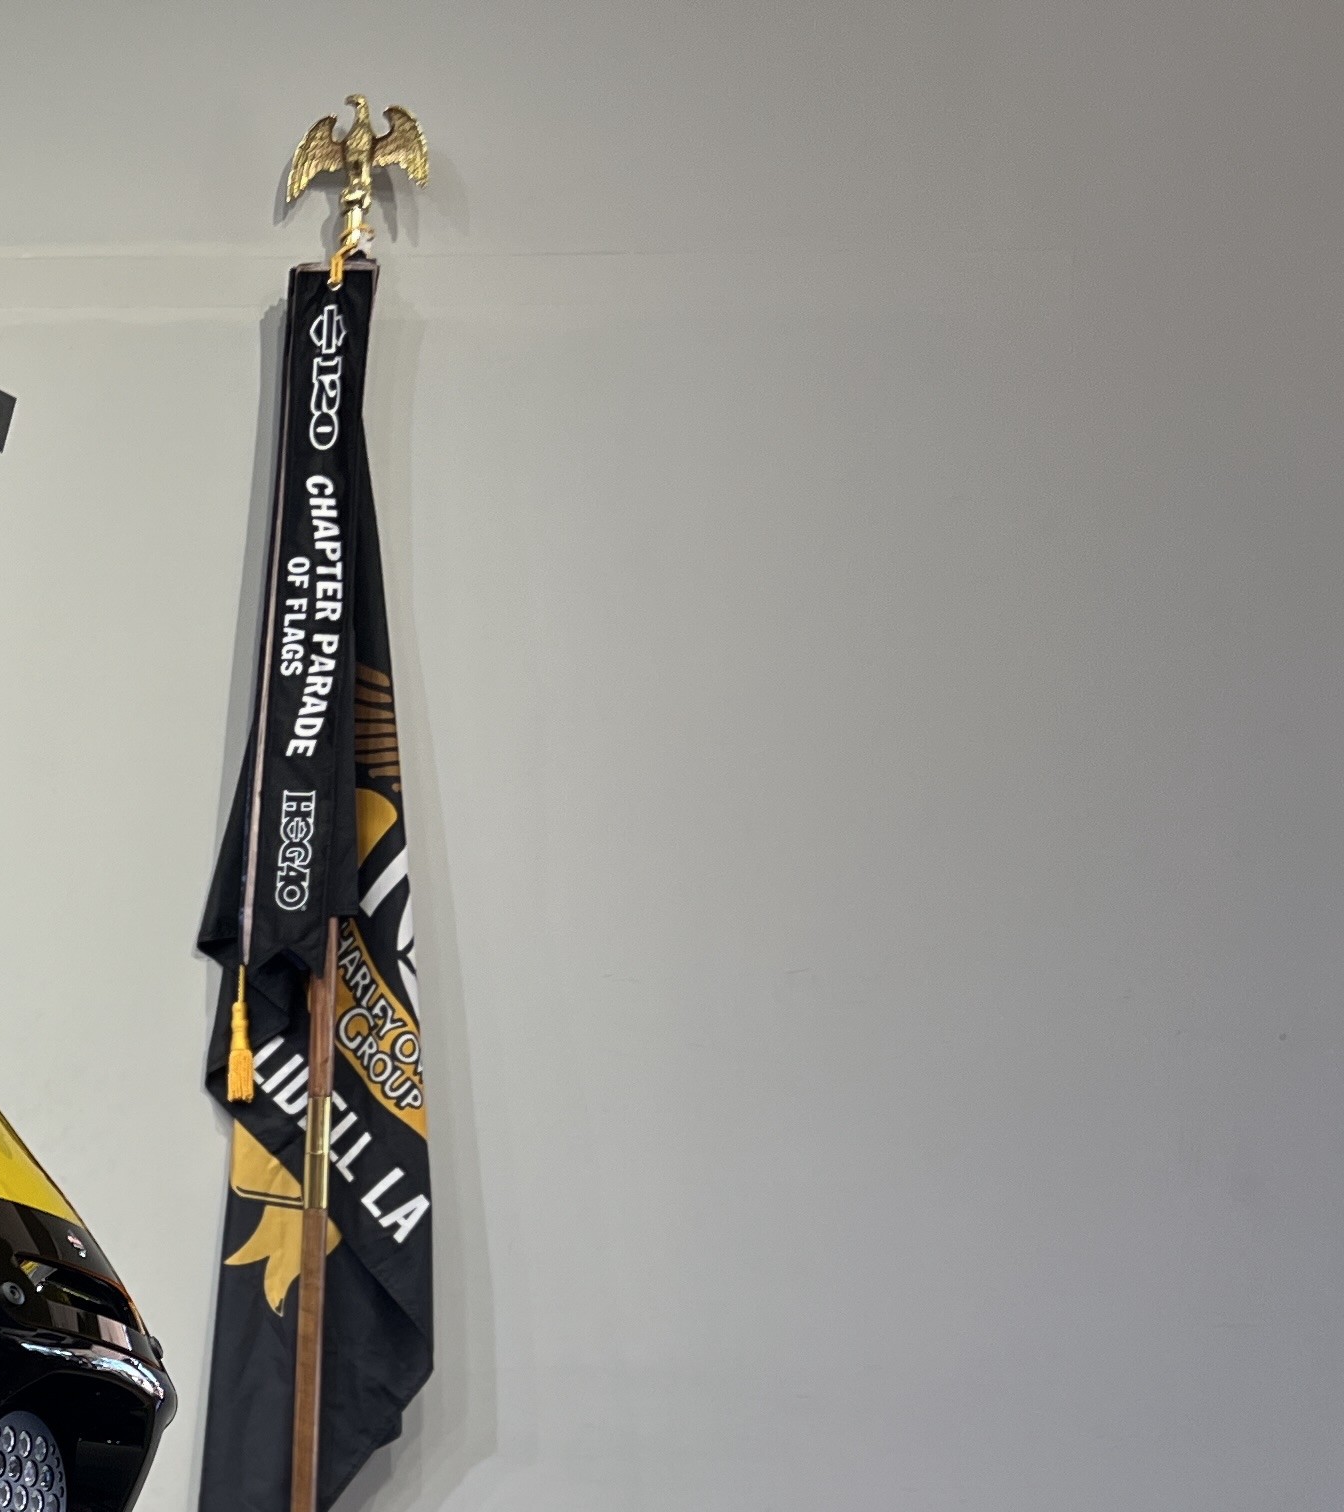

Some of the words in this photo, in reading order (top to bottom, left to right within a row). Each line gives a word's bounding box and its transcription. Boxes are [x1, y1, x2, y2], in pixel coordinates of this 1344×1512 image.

[309, 355, 343, 450] 120
[287, 556, 311, 589] OF
[305, 475, 343, 622] CHAPTER
[279, 597, 308, 677] FLAGS
[285, 633, 340, 757] PARADE
[338, 1007, 424, 1111] GROUP
[252, 1035, 372, 1183] LIDLL
[360, 1166, 430, 1244] LA
